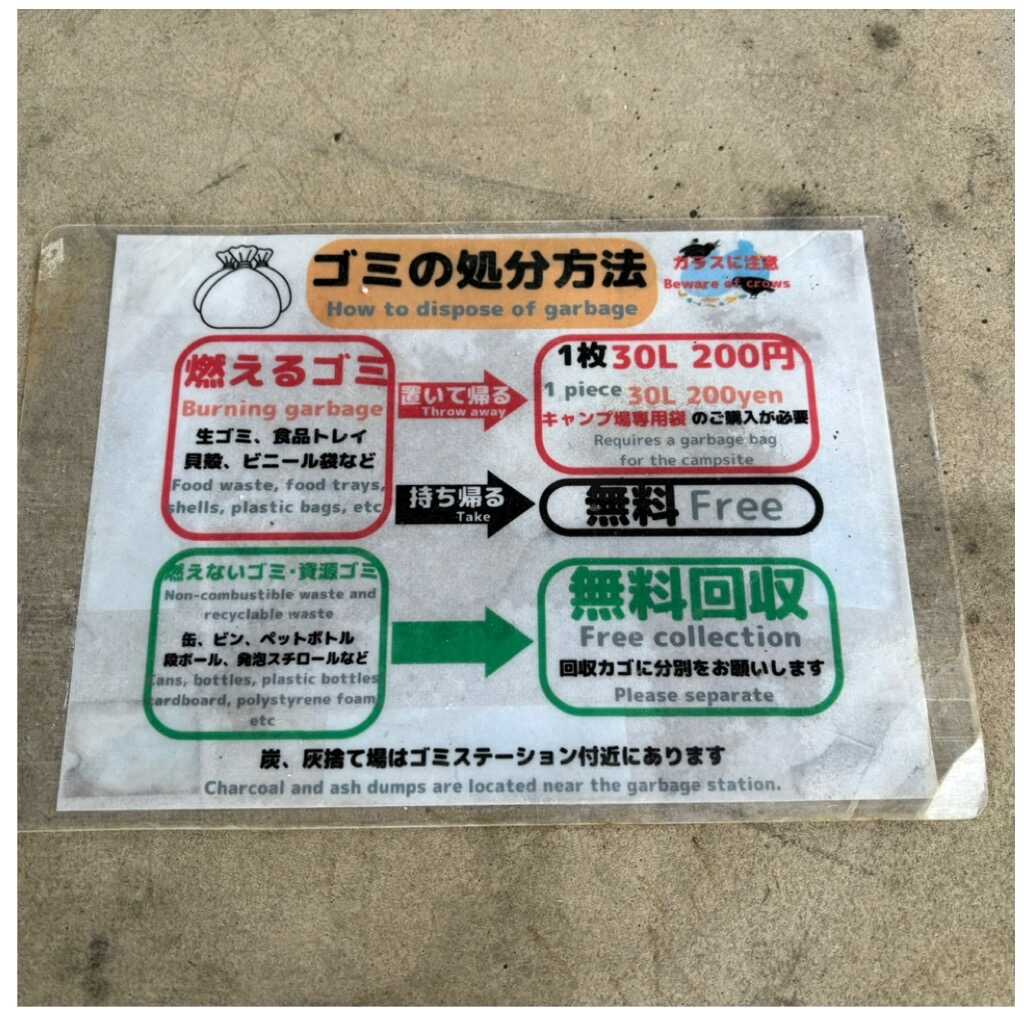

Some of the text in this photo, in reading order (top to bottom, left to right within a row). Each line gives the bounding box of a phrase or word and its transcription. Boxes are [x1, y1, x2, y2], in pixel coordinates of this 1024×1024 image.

[312, 249, 648, 290] ゴミの処分方法
[664, 278, 792, 290] Beware of crows
[327, 300, 639, 322] How to dispose of garbage
[692, 343, 796, 370] 200円
[183, 353, 389, 389] 燃えるゴミ
[401, 385, 512, 406] 置いて帰る
[544, 381, 785, 409] 1 piece 30L 200yen
[182, 400, 384, 423] Burning garbage
[421, 406, 507, 420] Throw away
[196, 427, 368, 445] 生ゴミ、食品トレイ
[594, 433, 778, 451] Requires a garbage bag
[184, 452, 377, 470] 貝殻、ビニール袋など
[620, 453, 755, 470] for the campsite
[172, 478, 386, 495] Food waste, food trays,
[409, 485, 506, 510] 持ち帰る
[585, 485, 784, 527] 無料 Free
[167, 501, 226, 517] shells,
[231, 500, 294, 517] plastic
[300, 500, 347, 516] bags,
[455, 511, 491, 523] Take
[164, 588, 377, 602] Non-combustible waste and
[569, 566, 810, 622] 無料回収
[204, 608, 334, 622] recyclable waste
[181, 631, 355, 647] 缶、ビン、ペットボトル
[579, 624, 801, 649] Free collection
[163, 651, 369, 668] 段ボール、発泡スチロールなど
[559, 659, 826, 678] 回収カゴに分別をお願いします
[193, 672, 257, 687] bottles,
[261, 672, 316, 687] plastic
[236, 692, 331, 709] polystyrene
[614, 687, 775, 705] Please separate
[249, 715, 276, 727] etc
[259, 745, 726, 770] 炭、灰捨て場はゴミステーション付近にあります
[204, 776, 782, 799] Charcoal and ash dumps are located near the garbage station.
